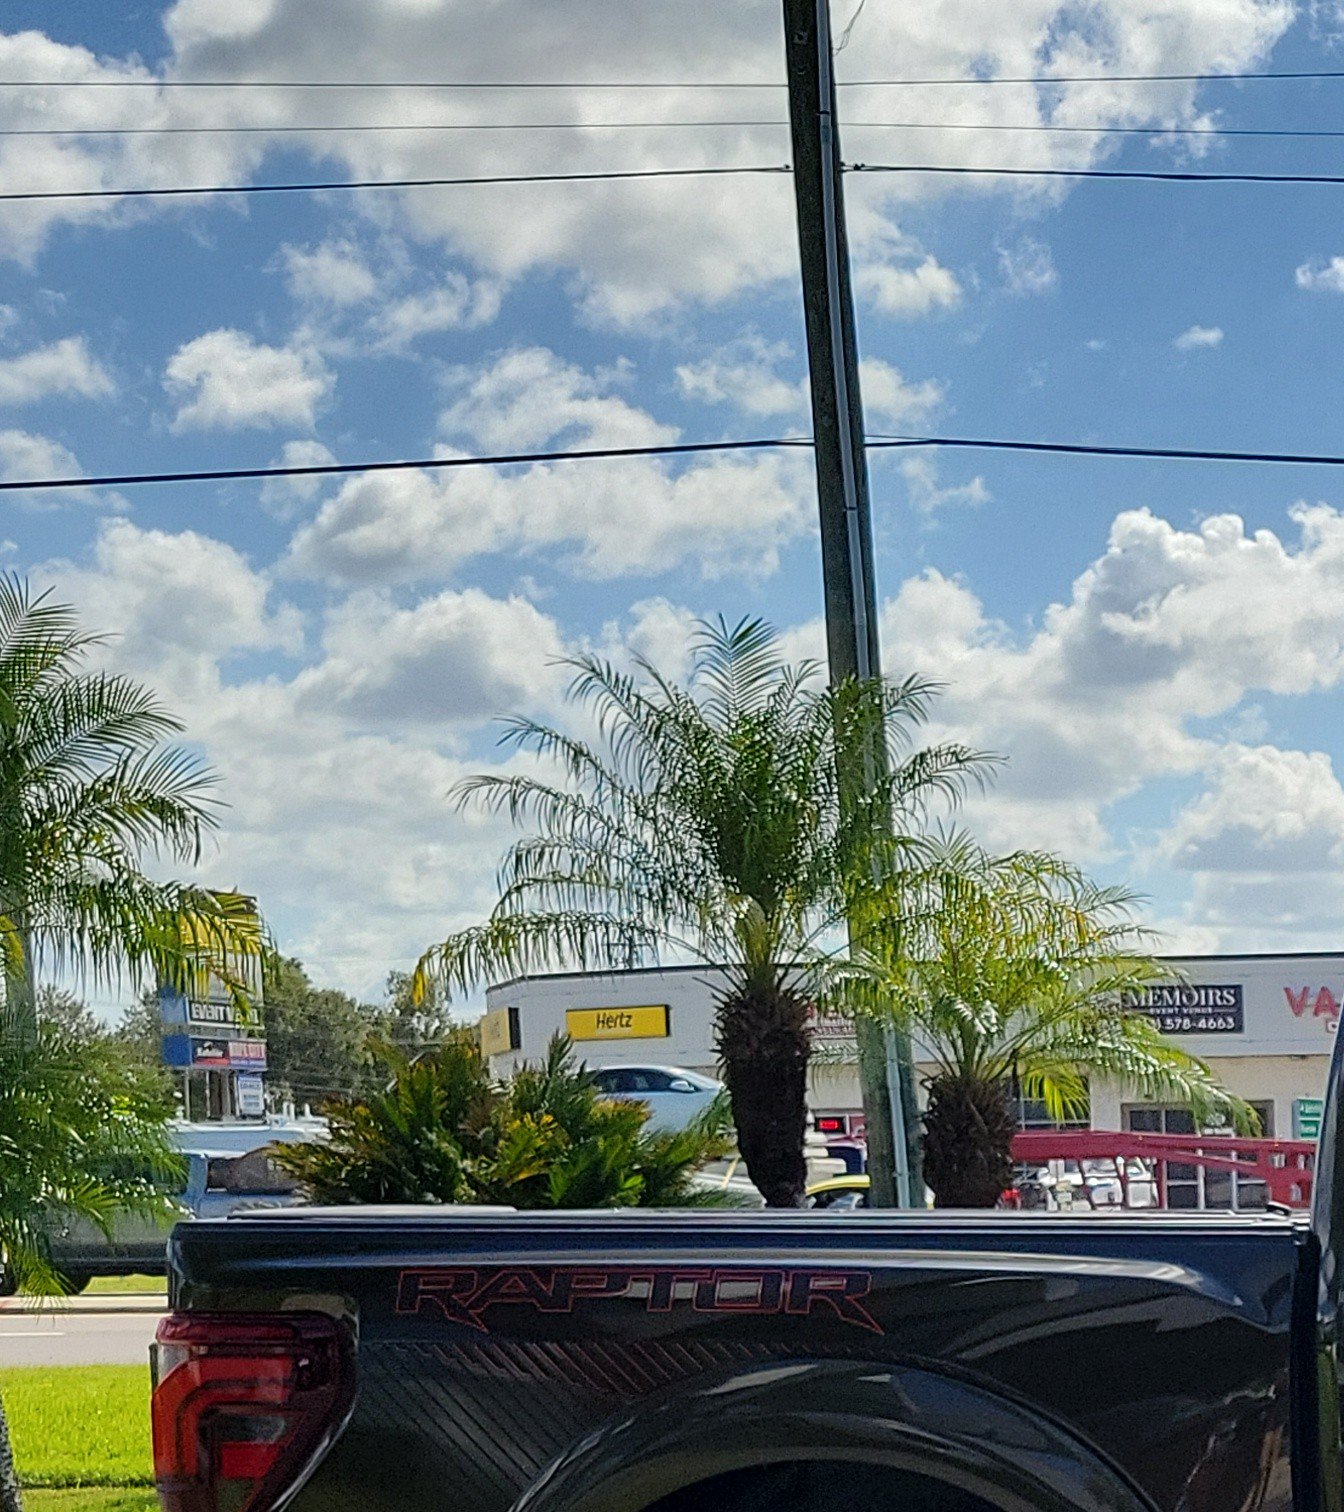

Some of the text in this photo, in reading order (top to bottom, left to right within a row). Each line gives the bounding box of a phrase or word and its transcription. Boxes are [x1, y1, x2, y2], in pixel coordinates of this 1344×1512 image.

[1126, 988, 1236, 1007] MEMOIRS
[596, 1012, 633, 1029] Hertz
[396, 1268, 886, 1336] RAPTOR
